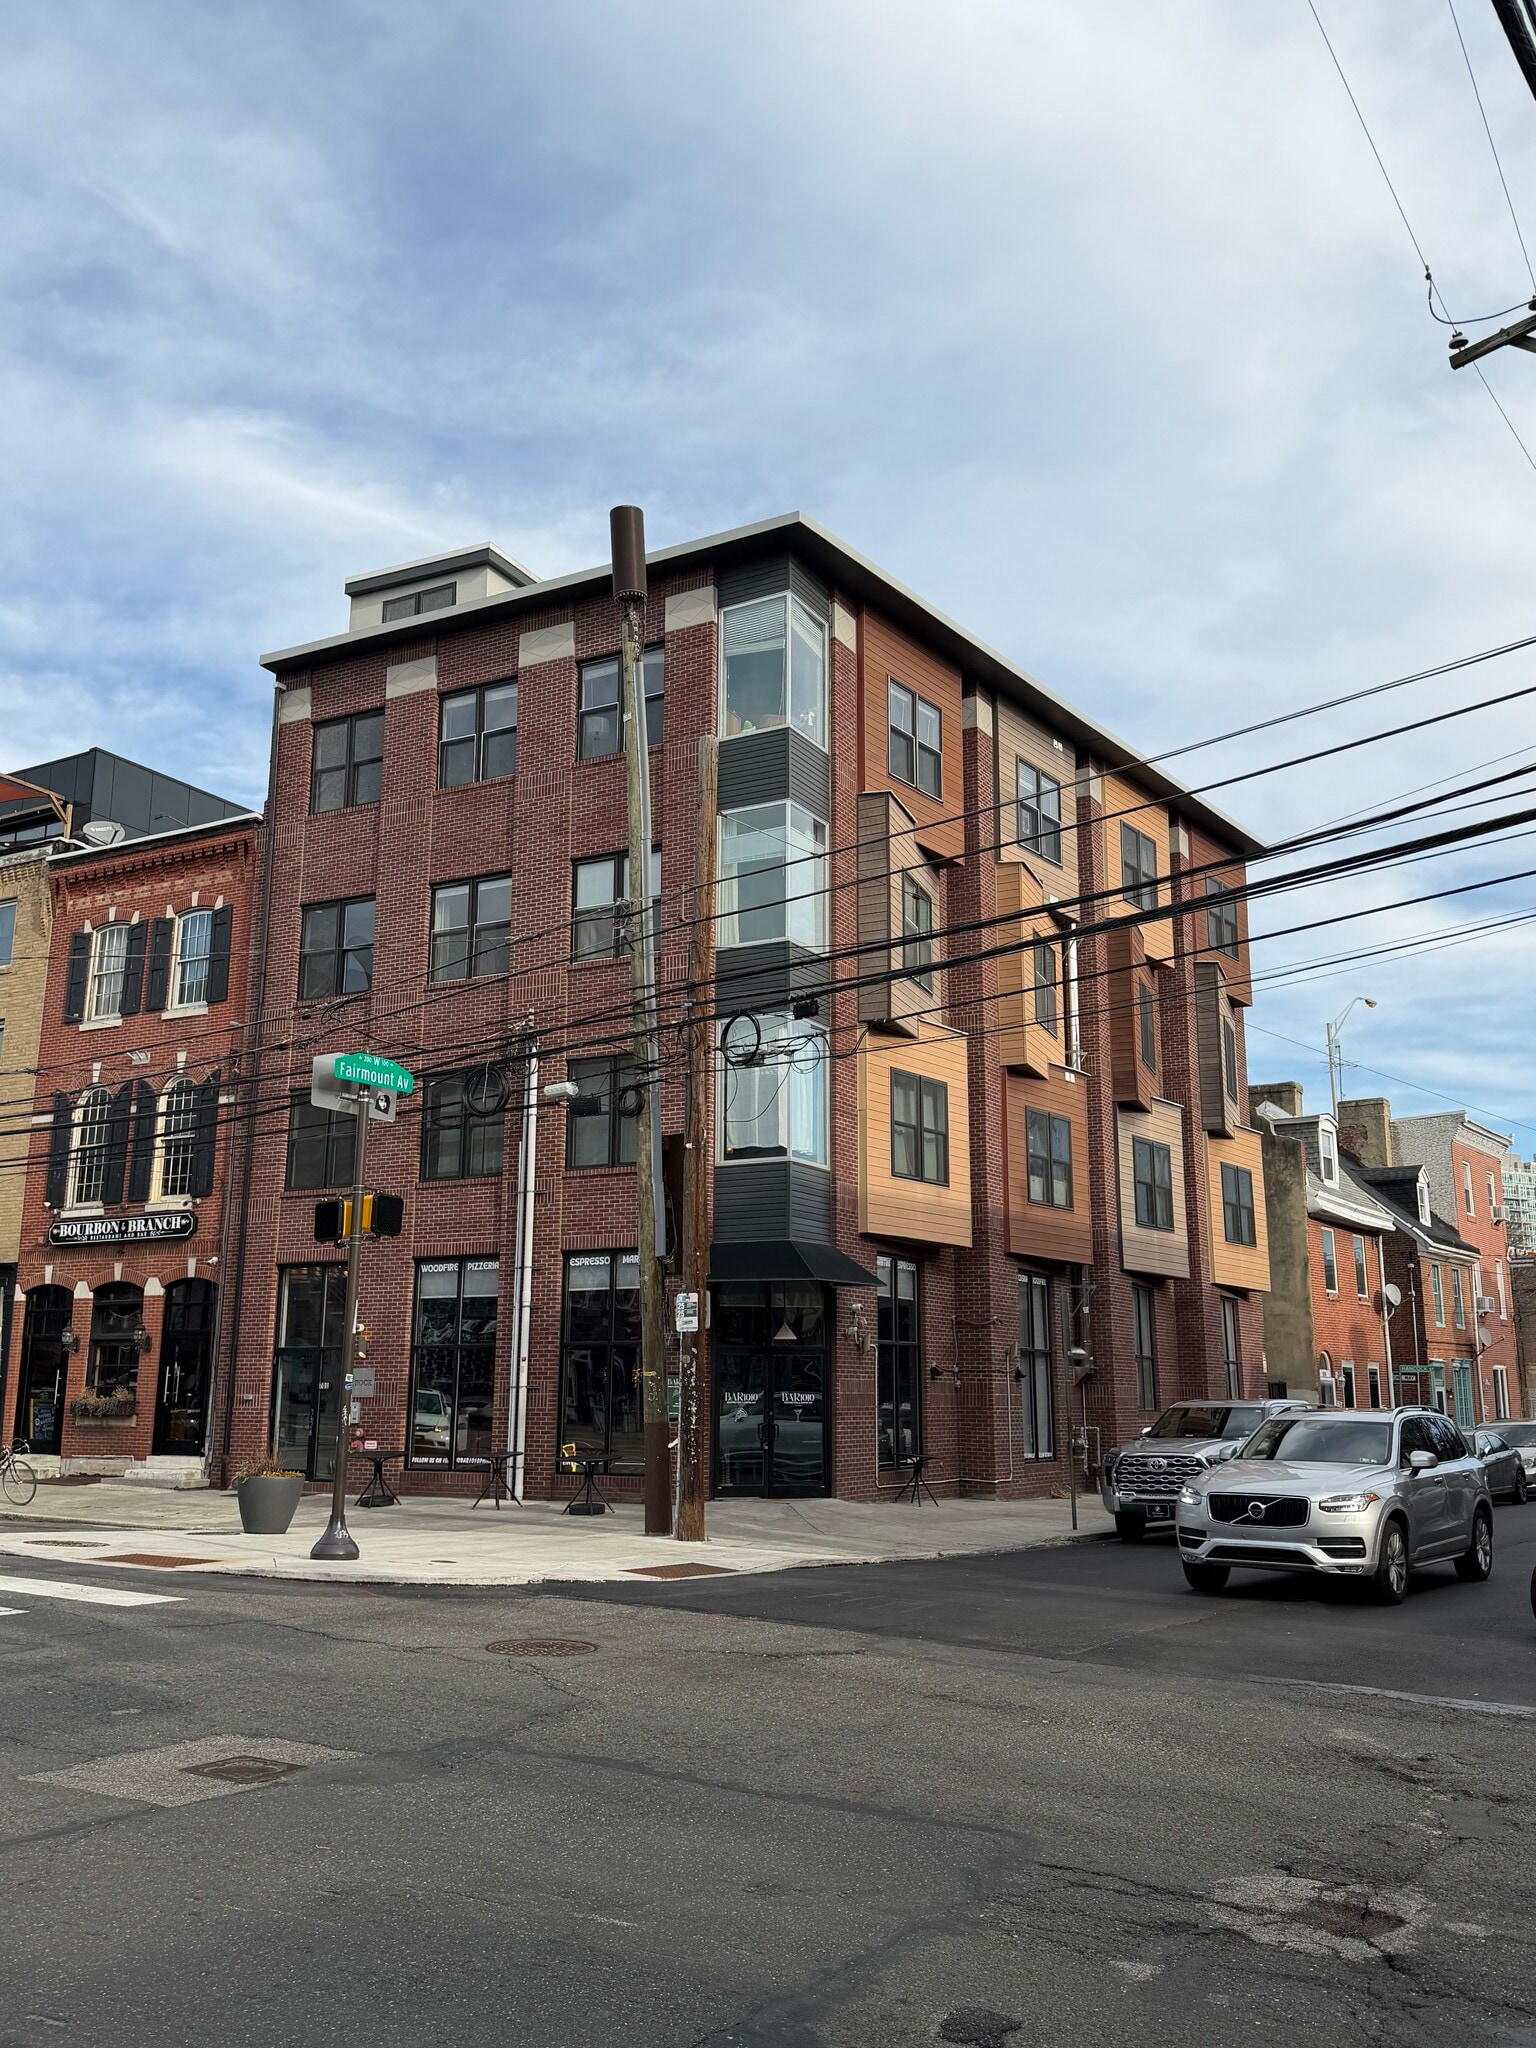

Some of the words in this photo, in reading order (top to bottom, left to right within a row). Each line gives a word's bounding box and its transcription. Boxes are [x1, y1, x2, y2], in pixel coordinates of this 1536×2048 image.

[373, 1056, 381, 1066] W
[340, 1062, 395, 1086] Fairmount
[397, 1075, 409, 1090] Av
[59, 1220, 121, 1237] BOURBON
[128, 1216, 182, 1232] BRANCH
[90, 1233, 122, 1241] RESTAURANT
[569, 1256, 611, 1266] ESPRESSO
[622, 1254, 640, 1264] MAR
[421, 1263, 459, 1273] WOODFIRE
[467, 1261, 500, 1271] PIZZERIA
[724, 1391, 759, 1402] BAR1010
[781, 1392, 815, 1402] BAR1010
[411, 1456, 429, 1464] FOLLOW
